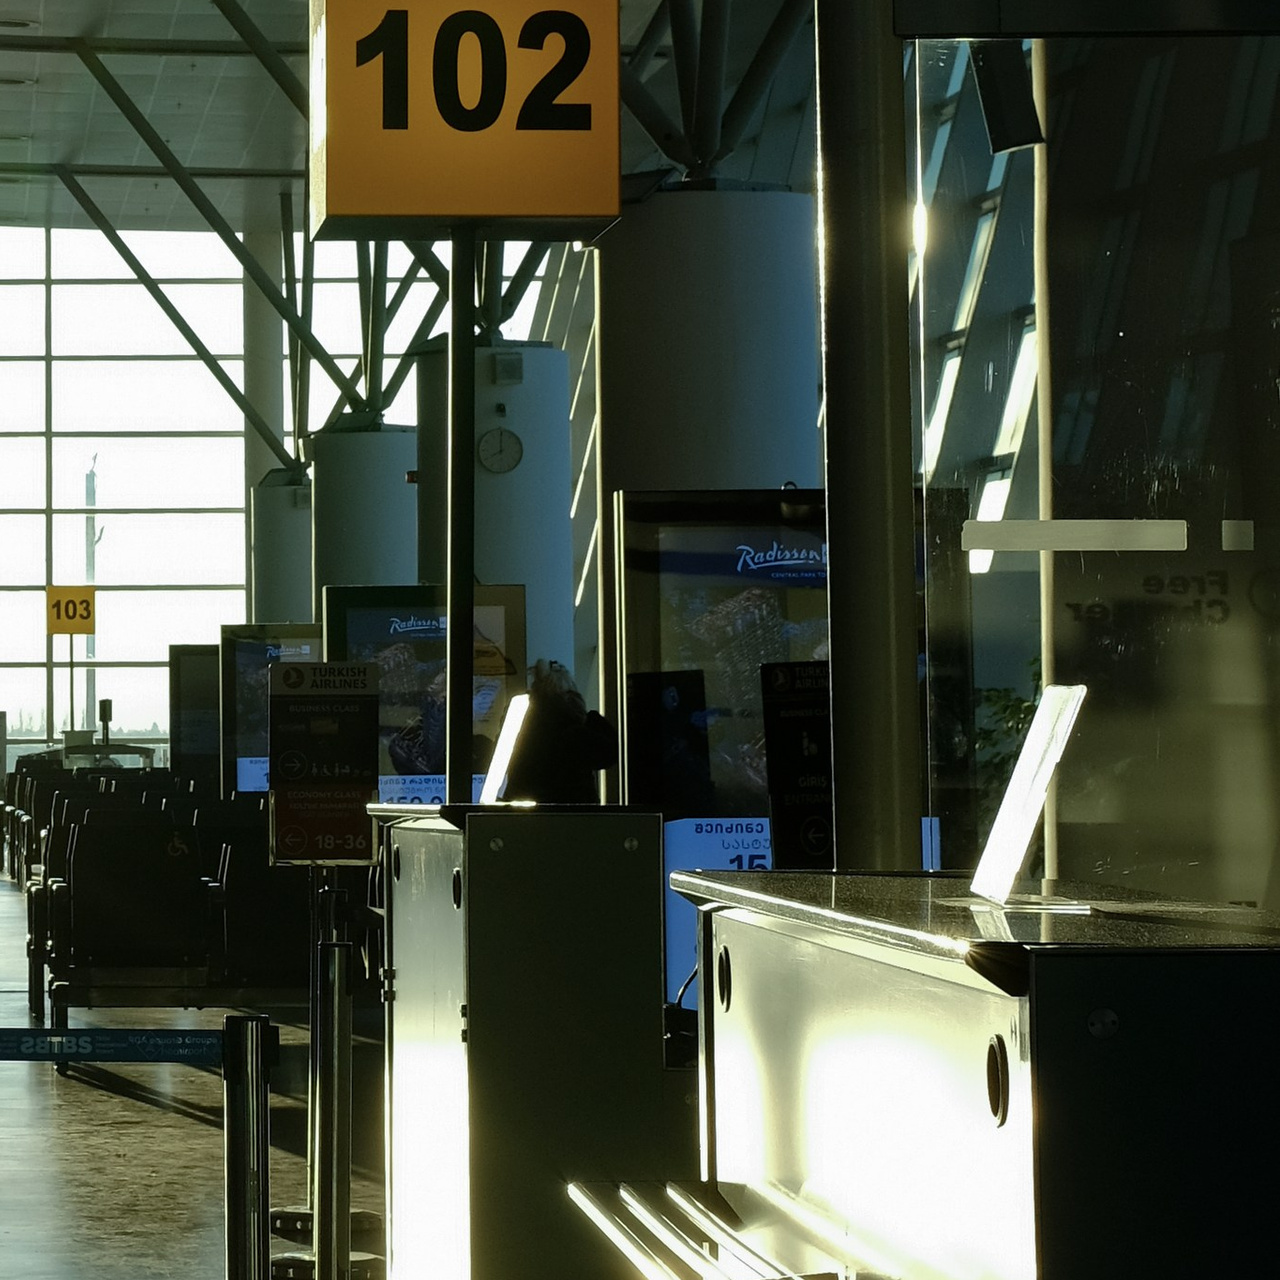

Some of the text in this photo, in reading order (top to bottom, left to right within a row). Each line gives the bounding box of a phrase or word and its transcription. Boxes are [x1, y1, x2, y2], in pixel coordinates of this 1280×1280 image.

[356, 10, 592, 132] 102
[736, 540, 820, 573] Radisson
[51, 599, 91, 620] 103
[310, 666, 367, 678] TURKISH
[310, 678, 367, 690] AIRLINES
[795, 678, 828, 689] AIRLIN
[315, 834, 367, 850] 18-36
[729, 854, 768, 870] 15
